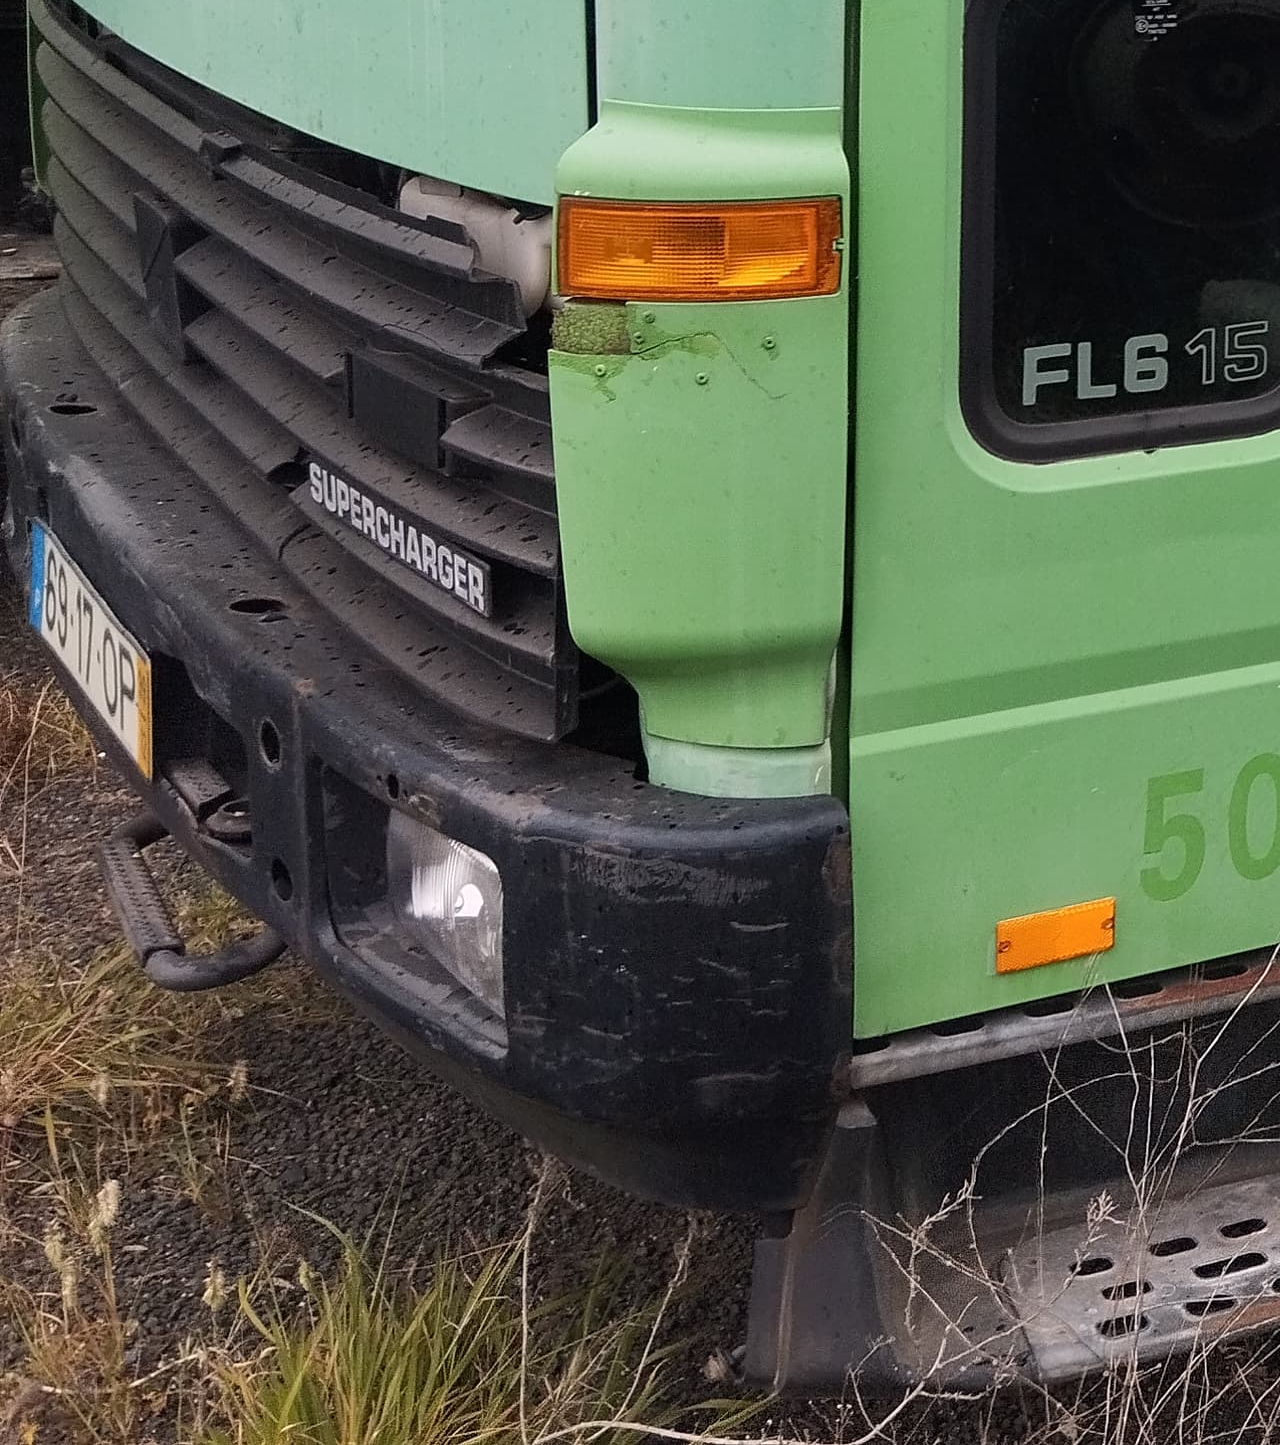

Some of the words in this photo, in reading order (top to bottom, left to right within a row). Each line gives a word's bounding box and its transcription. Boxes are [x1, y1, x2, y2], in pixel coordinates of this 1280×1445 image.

[1021, 332, 1170, 407] FL6
[1184, 319, 1270, 387] 15
[308, 462, 486, 612] SUPERCHARGER
